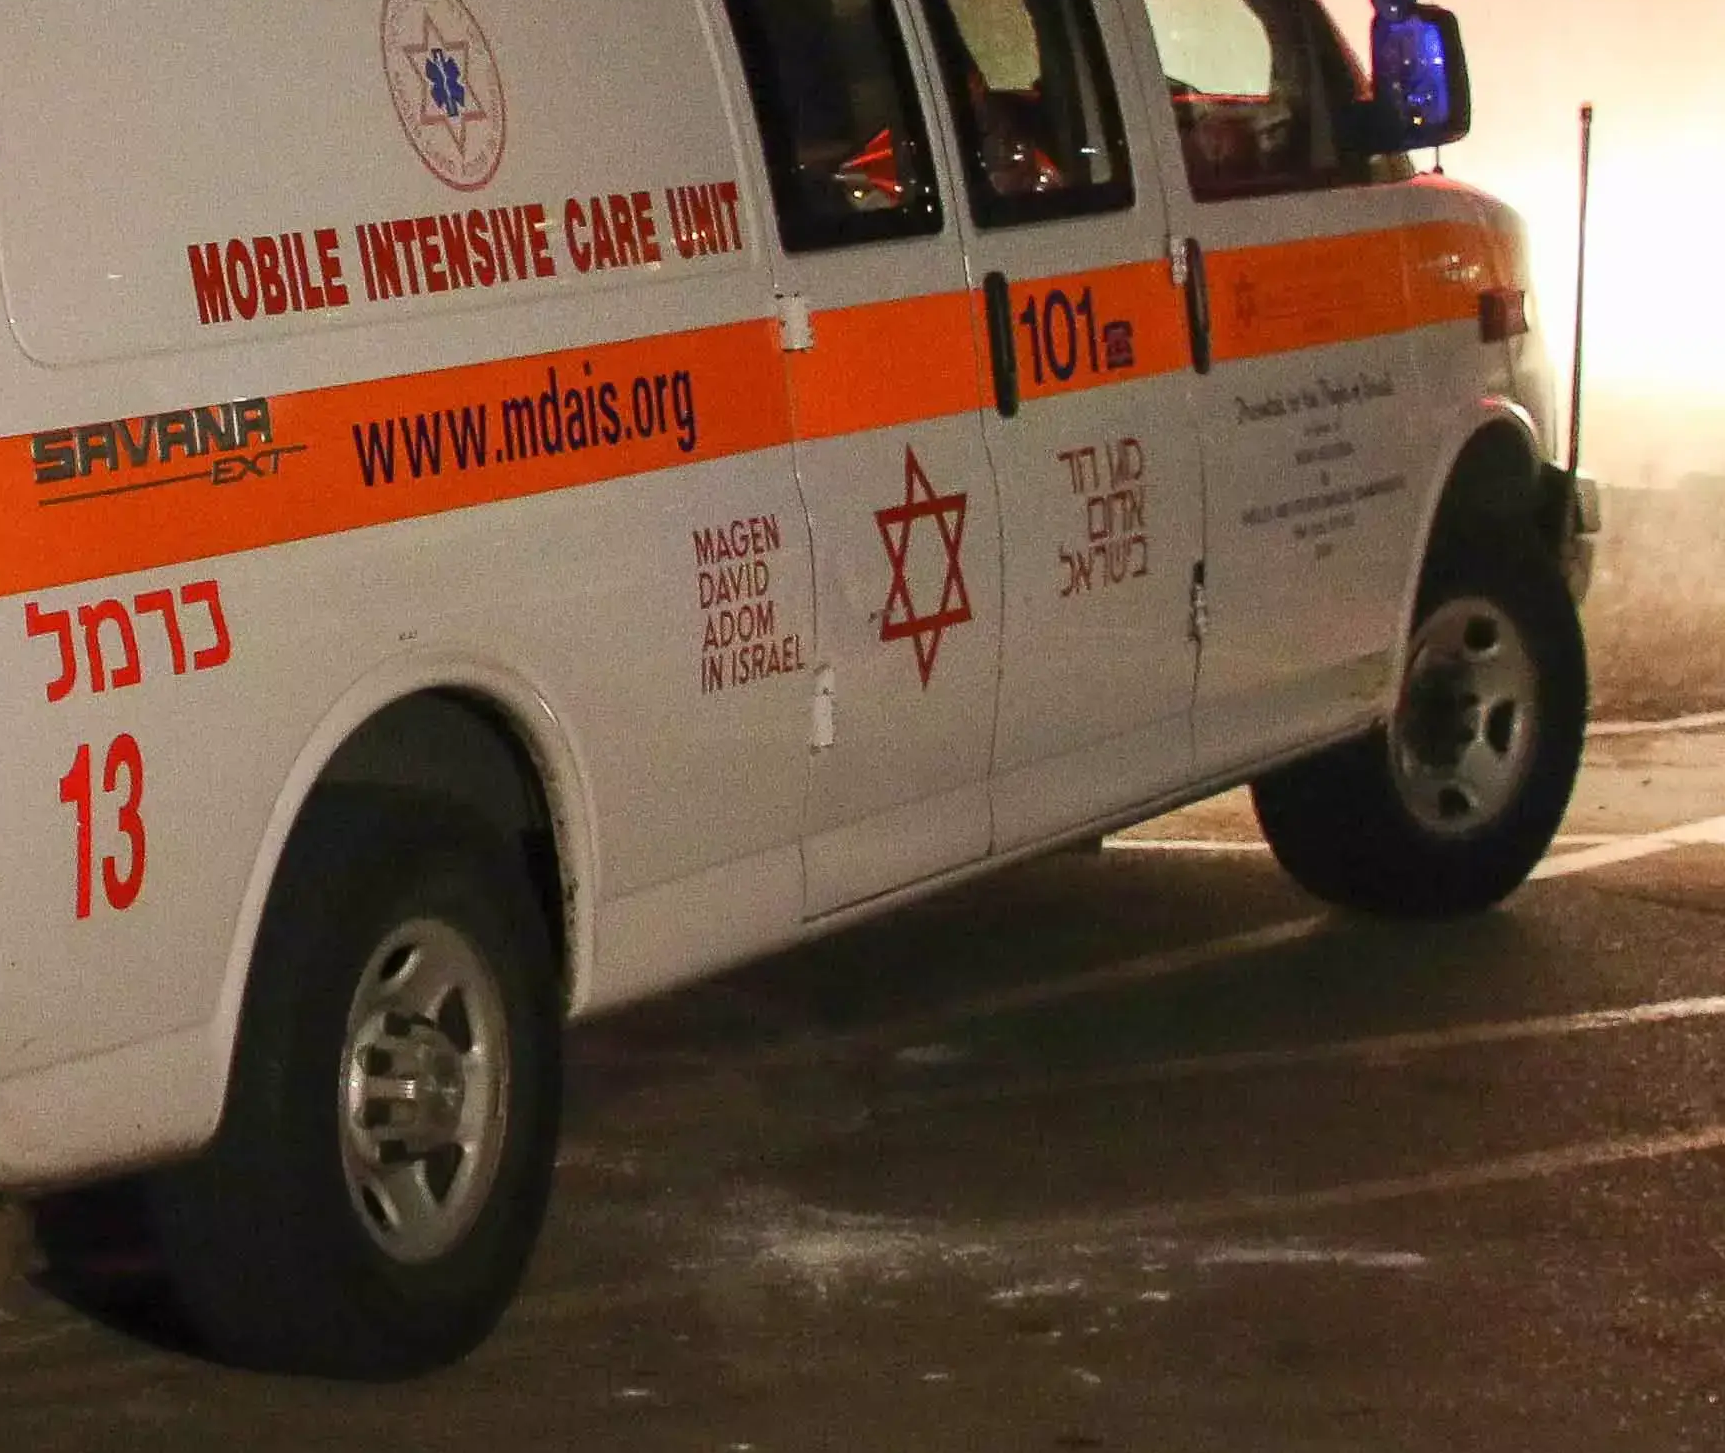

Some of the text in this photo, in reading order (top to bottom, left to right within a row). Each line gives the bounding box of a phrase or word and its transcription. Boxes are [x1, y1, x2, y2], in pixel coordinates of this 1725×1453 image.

[187, 180, 744, 325] MOBILE INTENSIVE CARE UNIT
[1020, 285, 1099, 386] 101
[30, 396, 274, 484] SAVANA
[210, 445, 299, 486] EXT
[351, 359, 698, 488] www.mdais.org
[692, 513, 780, 567] MAGEN
[699, 559, 770, 610] DAVID
[702, 599, 775, 652] ADOM
[23, 577, 232, 704] כרמל
[701, 633, 805, 695] IN ISRAEL
[58, 732, 147, 919] 13
